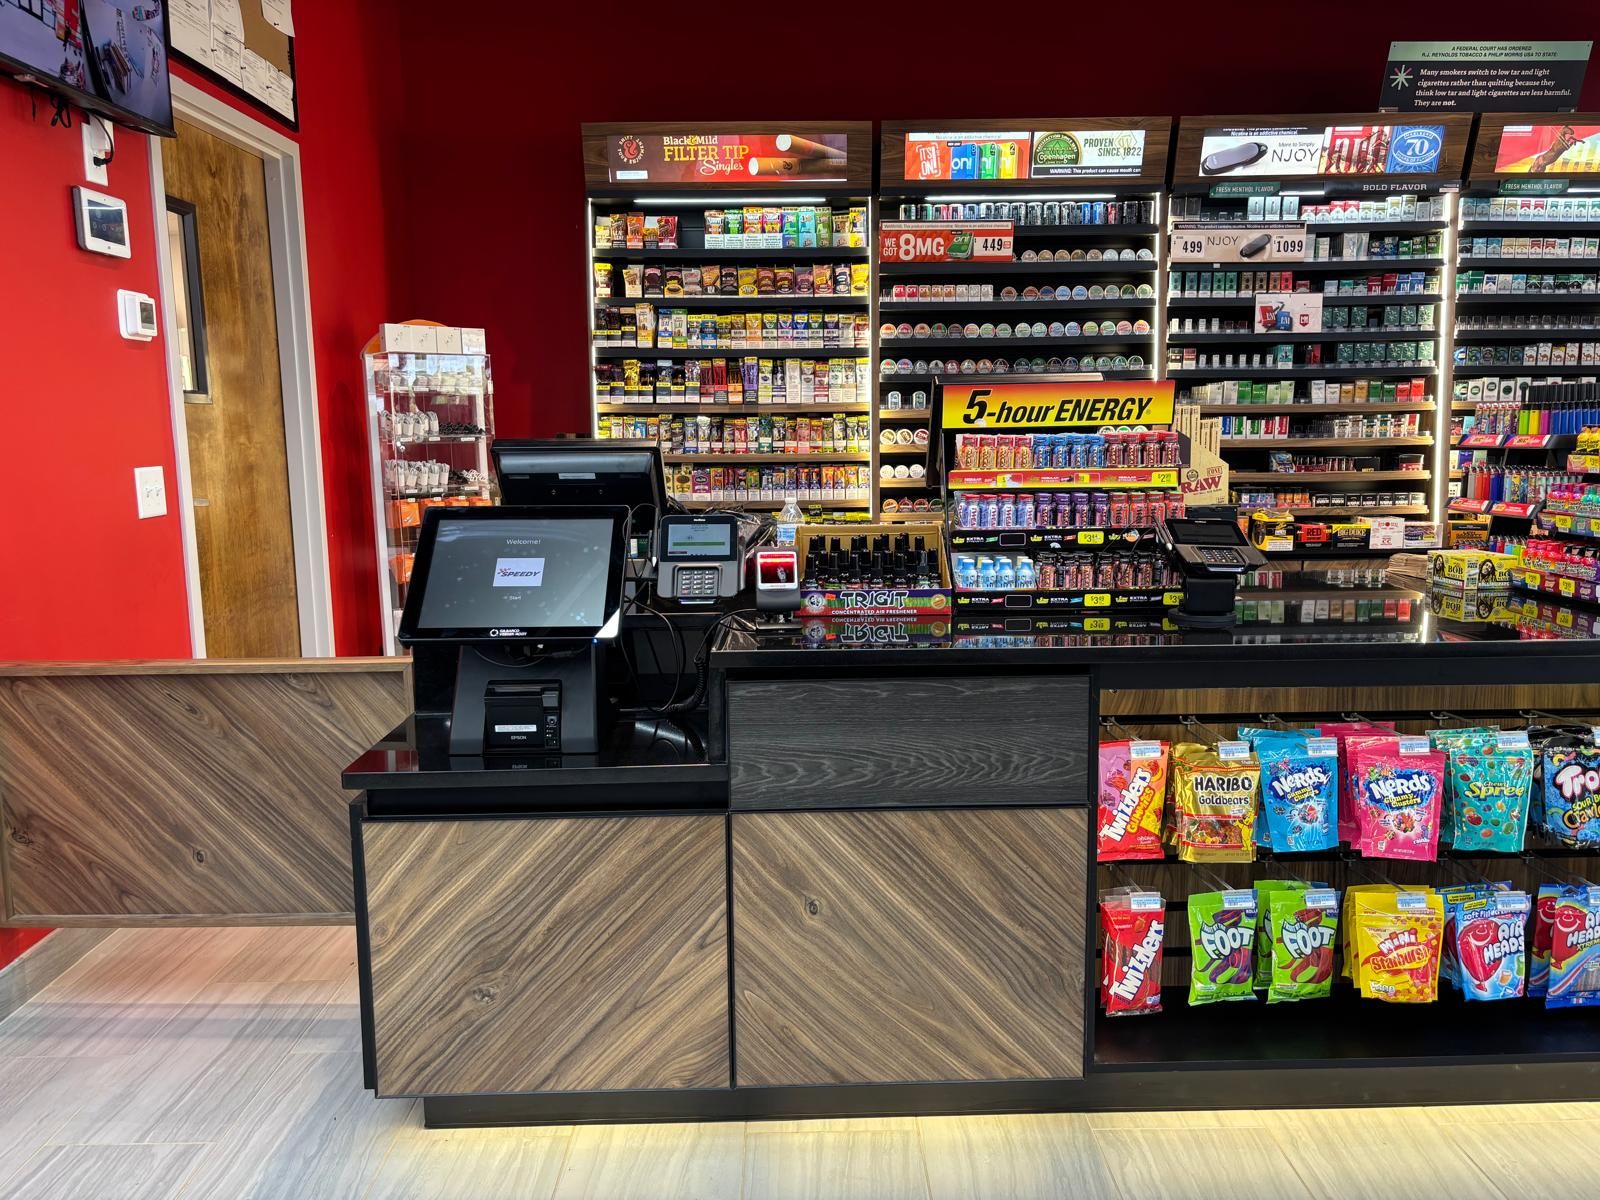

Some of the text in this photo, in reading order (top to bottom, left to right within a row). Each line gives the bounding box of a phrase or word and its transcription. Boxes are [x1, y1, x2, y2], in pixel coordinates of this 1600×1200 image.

[1084, 138, 1115, 148] PROVEN
[1405, 139, 1429, 156] 70
[664, 145, 749, 161] FILTER TIP
[1038, 152, 1076, 164] Copenhagen
[1098, 147, 1141, 157] SINCE 1822
[1272, 148, 1319, 162] NJOY
[700, 158, 743, 175] Singles
[884, 238, 896, 246] WE
[1207, 236, 1238, 246] NJOY
[883, 248, 897, 256] GOT
[962, 389, 1153, 424] 5-hour ENERGY
[1181, 476, 1222, 494] RAW
[1306, 528, 1321, 536] RED
[1448, 565, 1463, 574] BOB
[840, 591, 908, 609] TRIGIT
[1194, 776, 1252, 791] HARIBO
[1555, 765, 1600, 798] Tro
[1465, 782, 1525, 799] Spree
[1199, 795, 1249, 805] Goldbears
[1384, 794, 1415, 804] Gummy
[1391, 799, 1420, 807] Clusters
[1573, 796, 1591, 810] SOUR
[1126, 785, 1155, 833] GUMMIES
[1464, 911, 1479, 920] soft
[1498, 921, 1524, 942] AIR
[1200, 927, 1255, 960] FOOT
[1282, 926, 1335, 960] FOOT
[1484, 936, 1524, 965] HEADS
